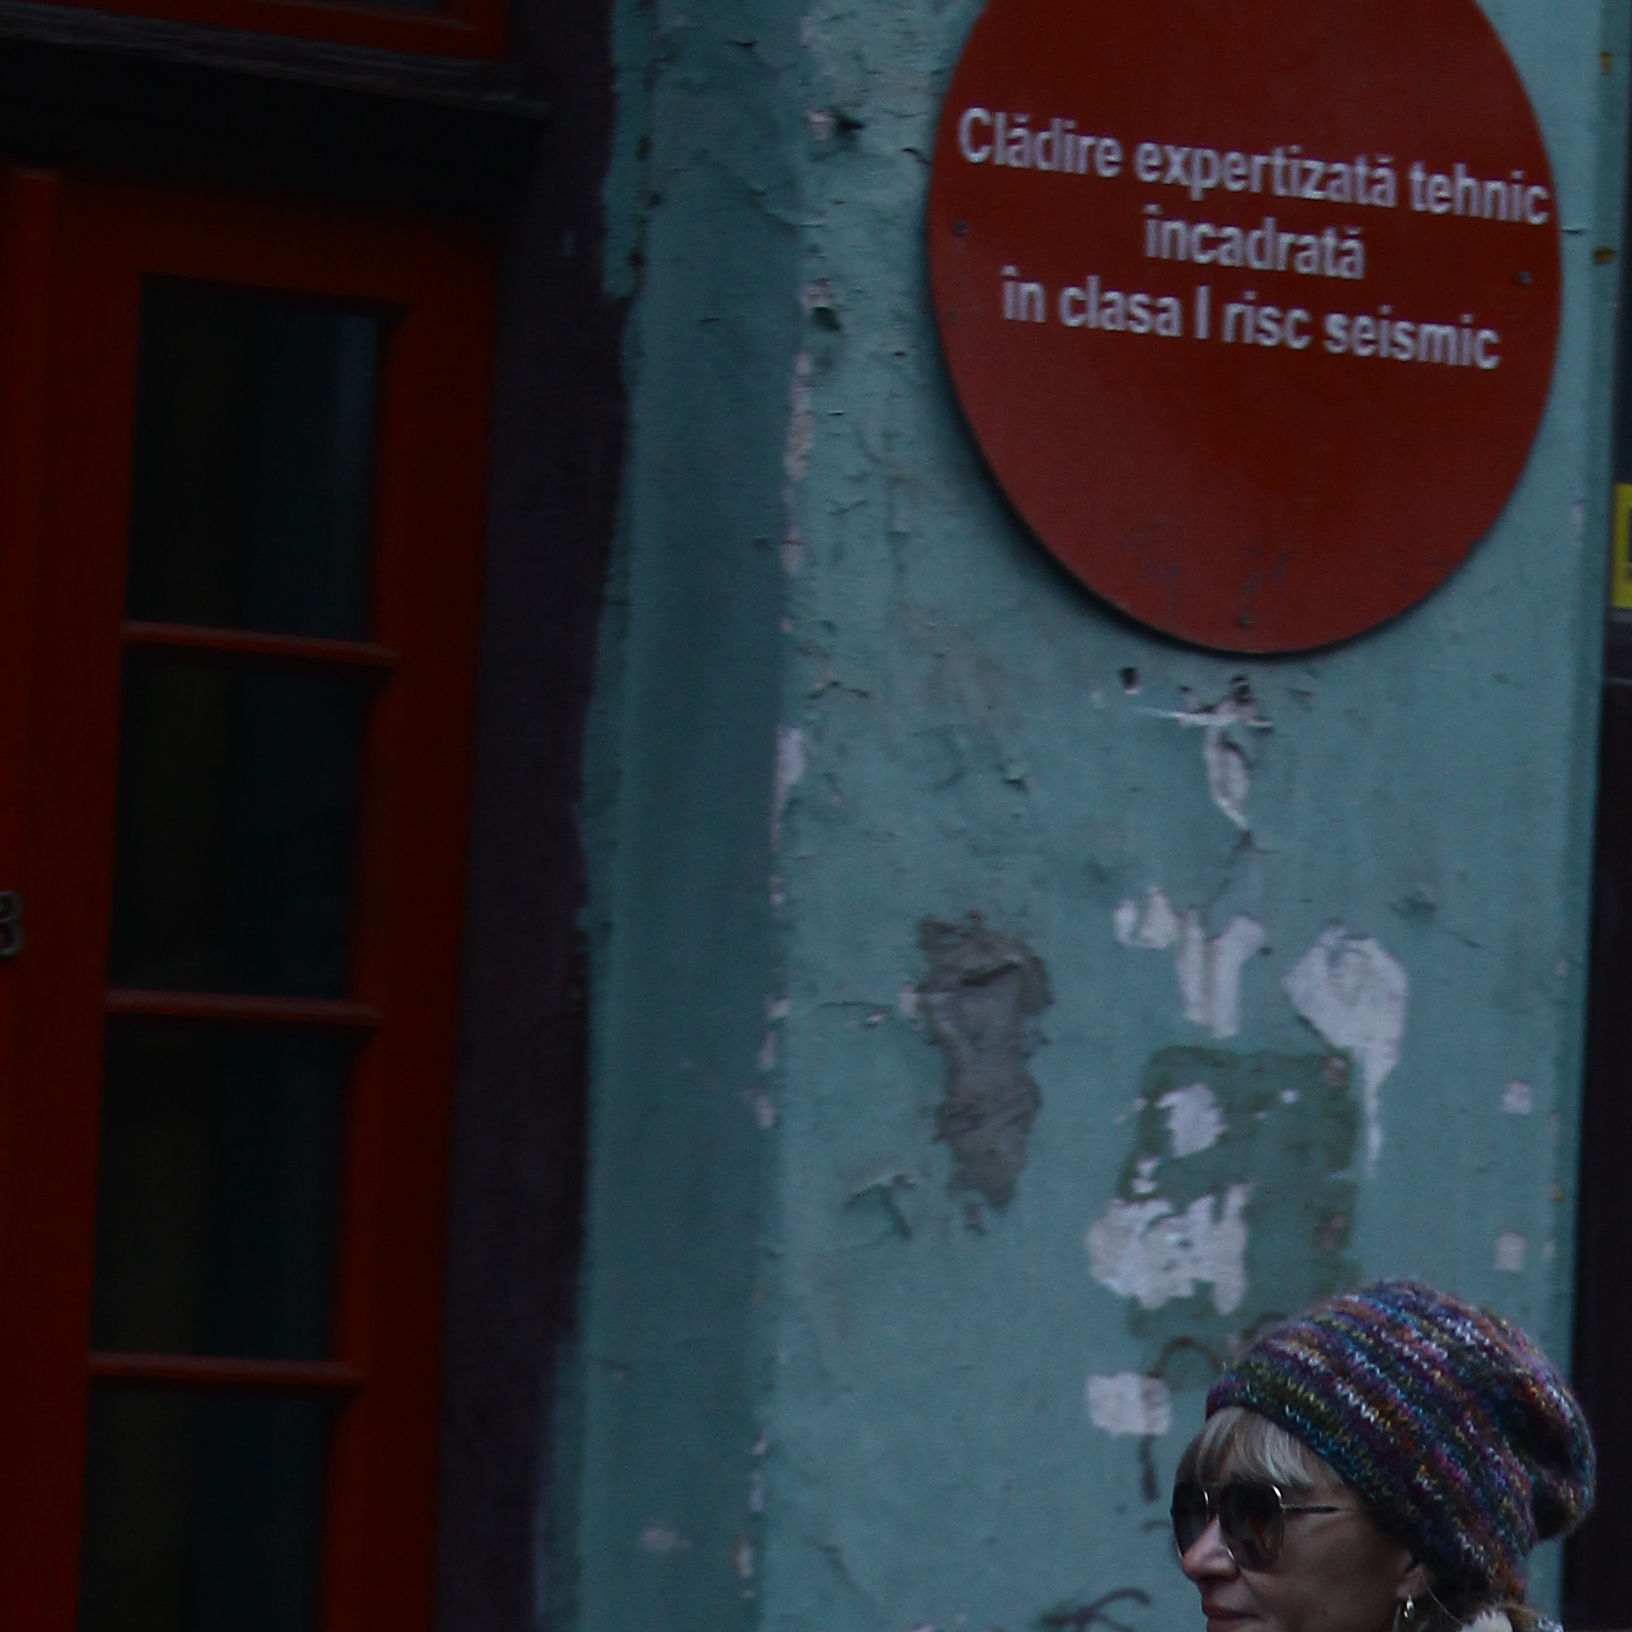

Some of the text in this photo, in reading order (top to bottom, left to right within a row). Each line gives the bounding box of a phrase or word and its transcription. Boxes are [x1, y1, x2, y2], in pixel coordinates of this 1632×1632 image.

[957, 106, 1550, 225] Clădire expertizată tehnic
[1143, 204, 1365, 280] încadrată
[1001, 263, 1501, 370] în clasa I risc seismic
